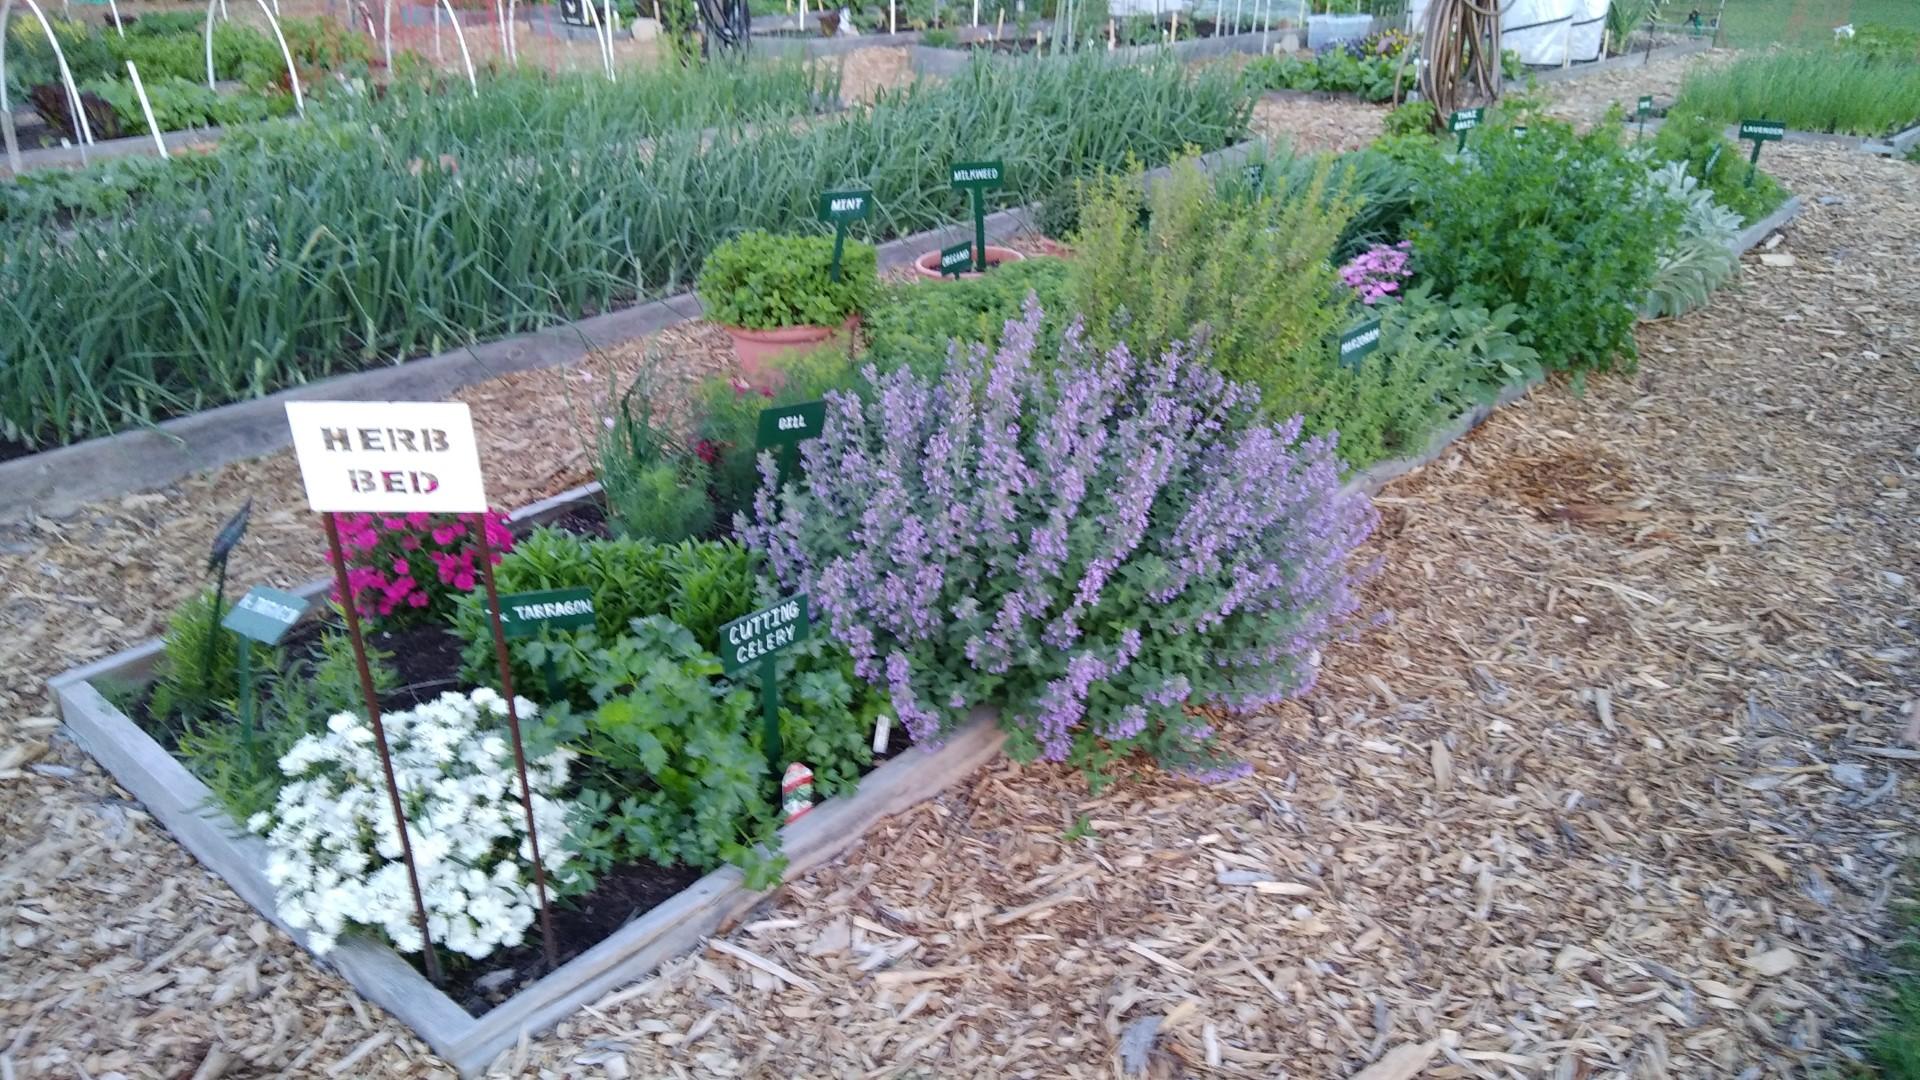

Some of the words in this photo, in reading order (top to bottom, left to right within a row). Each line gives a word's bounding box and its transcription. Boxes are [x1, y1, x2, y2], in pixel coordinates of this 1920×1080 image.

[1743, 125, 1783, 135] LAVENDER
[953, 167, 998, 181] MILKWEED
[831, 197, 863, 211] MINT
[779, 414, 807, 430] DILL
[320, 427, 449, 452] HERB
[348, 469, 439, 494] BED
[512, 599, 594, 621] TARRAGON
[729, 600, 800, 645] CUTTING
[736, 624, 796, 664] CELERY
